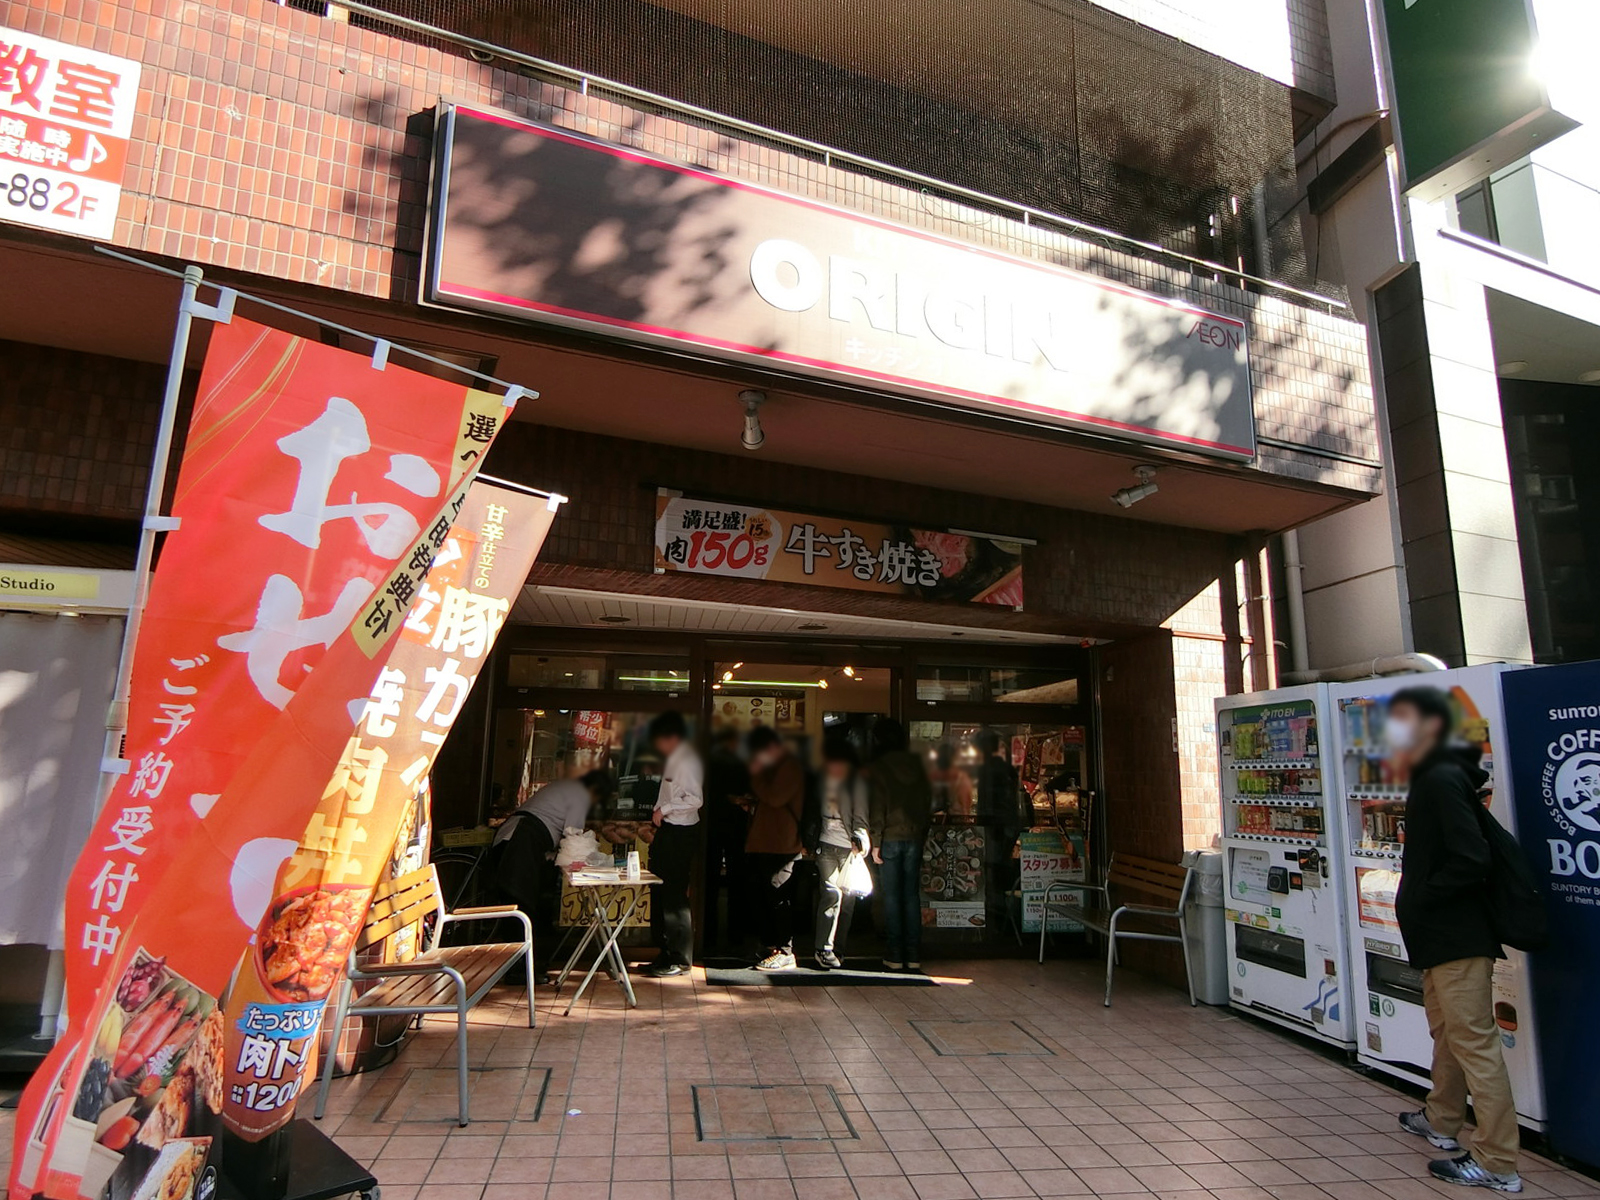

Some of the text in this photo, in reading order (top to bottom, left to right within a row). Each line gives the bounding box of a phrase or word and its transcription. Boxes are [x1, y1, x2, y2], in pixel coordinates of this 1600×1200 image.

[0, 41, 121, 129] 教室
[52, 181, 98, 219] 2F
[750, 239, 1066, 372] ORIGIN
[474, 504, 508, 588] 甘辛仕立ての
[785, 524, 942, 587] 牛すき焼き
[0, 576, 55, 590] Studio
[1270, 707, 1296, 719] ITO EN
[1549, 706, 1600, 720] SUNTO
[82, 654, 209, 966] ご予約受付中
[1542, 762, 1577, 836] BOSS COFFEE
[1551, 882, 1592, 894] SUNTORY
[246, 1007, 323, 1033] たっぷり
